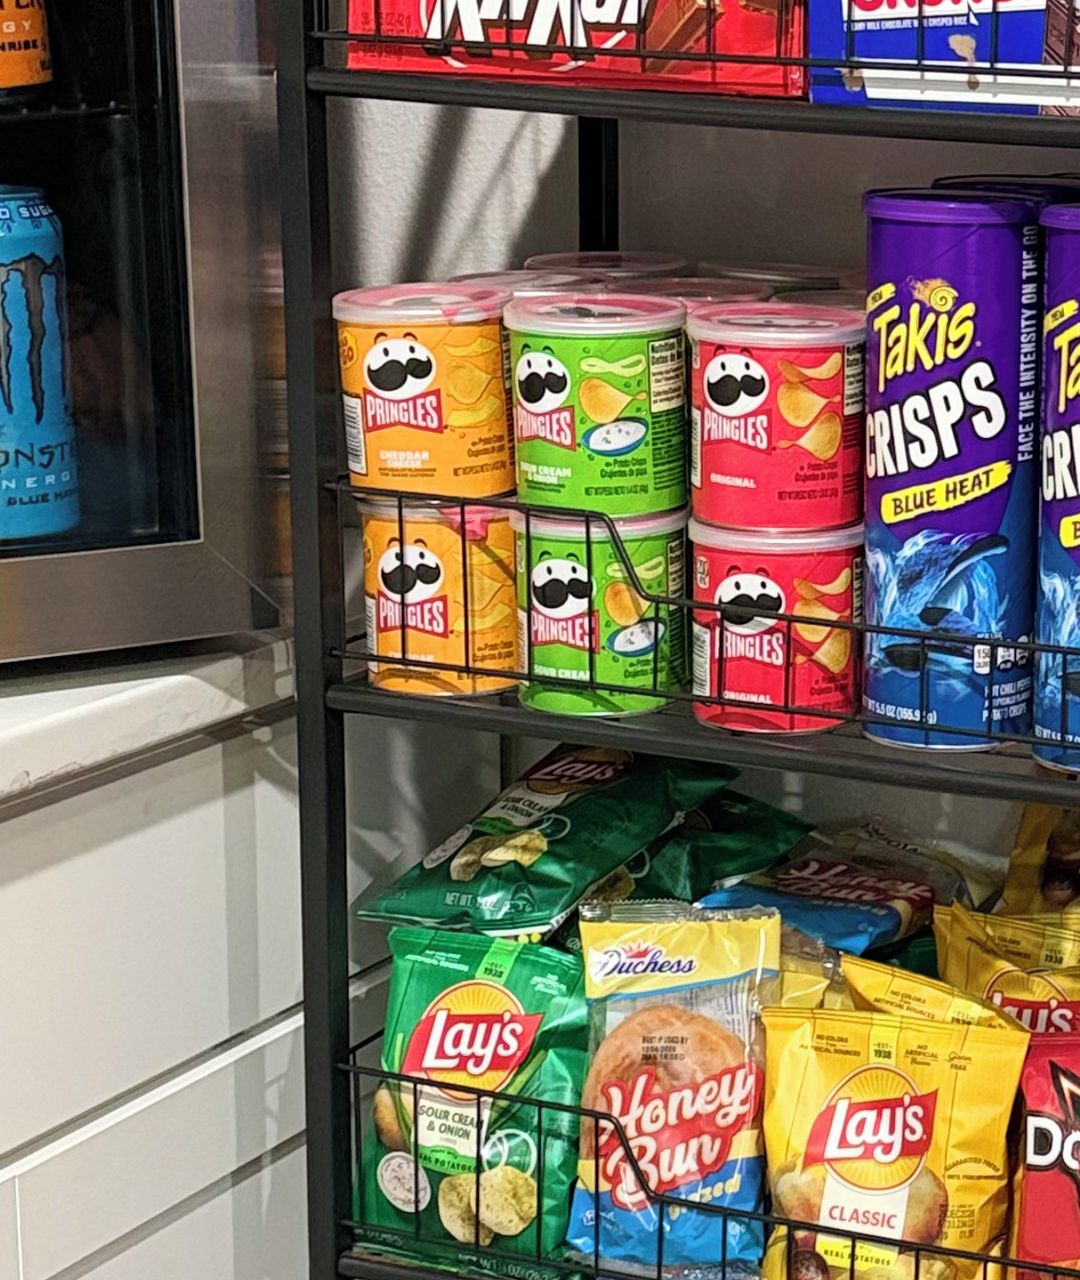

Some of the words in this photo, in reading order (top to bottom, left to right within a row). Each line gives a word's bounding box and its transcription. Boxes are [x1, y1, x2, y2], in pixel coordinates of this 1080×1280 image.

[1022, 247, 1038, 271] THE
[870, 290, 884, 302] NEW
[1021, 281, 1038, 304] ON
[1051, 308, 1065, 320] NEW
[873, 301, 976, 393] Takis
[1019, 307, 1038, 386] INTENSITY
[365, 389, 439, 430] PRINGLES
[1019, 389, 1037, 421] THE
[518, 408, 572, 447] PRINGLES
[703, 416, 768, 450] PRINGLES
[866, 361, 1006, 479] CRISPS
[379, 449, 430, 463] CHEDDAR
[1017, 423, 1034, 462] FACE
[539, 463, 572, 478] CREAM
[710, 473, 757, 488] ORIGINAL
[892, 492, 936, 517] BLUE
[944, 469, 995, 501] HEAT
[722, 690, 773, 706] ORIGINAL
[528, 756, 622, 784] Lay's
[596, 948, 696, 977] Duchess
[1044, 954, 1064, 965] 1938
[423, 1009, 523, 1075] Lay's
[874, 1049, 892, 1059] 1938
[418, 1105, 450, 1120] SOUR
[604, 1068, 755, 1140] Honey
[427, 1121, 435, 1131] &
[439, 1123, 471, 1140] ONION
[823, 1092, 927, 1164] Lay's
[606, 1131, 722, 1203] Bun
[828, 1205, 897, 1230] CLASSIC
